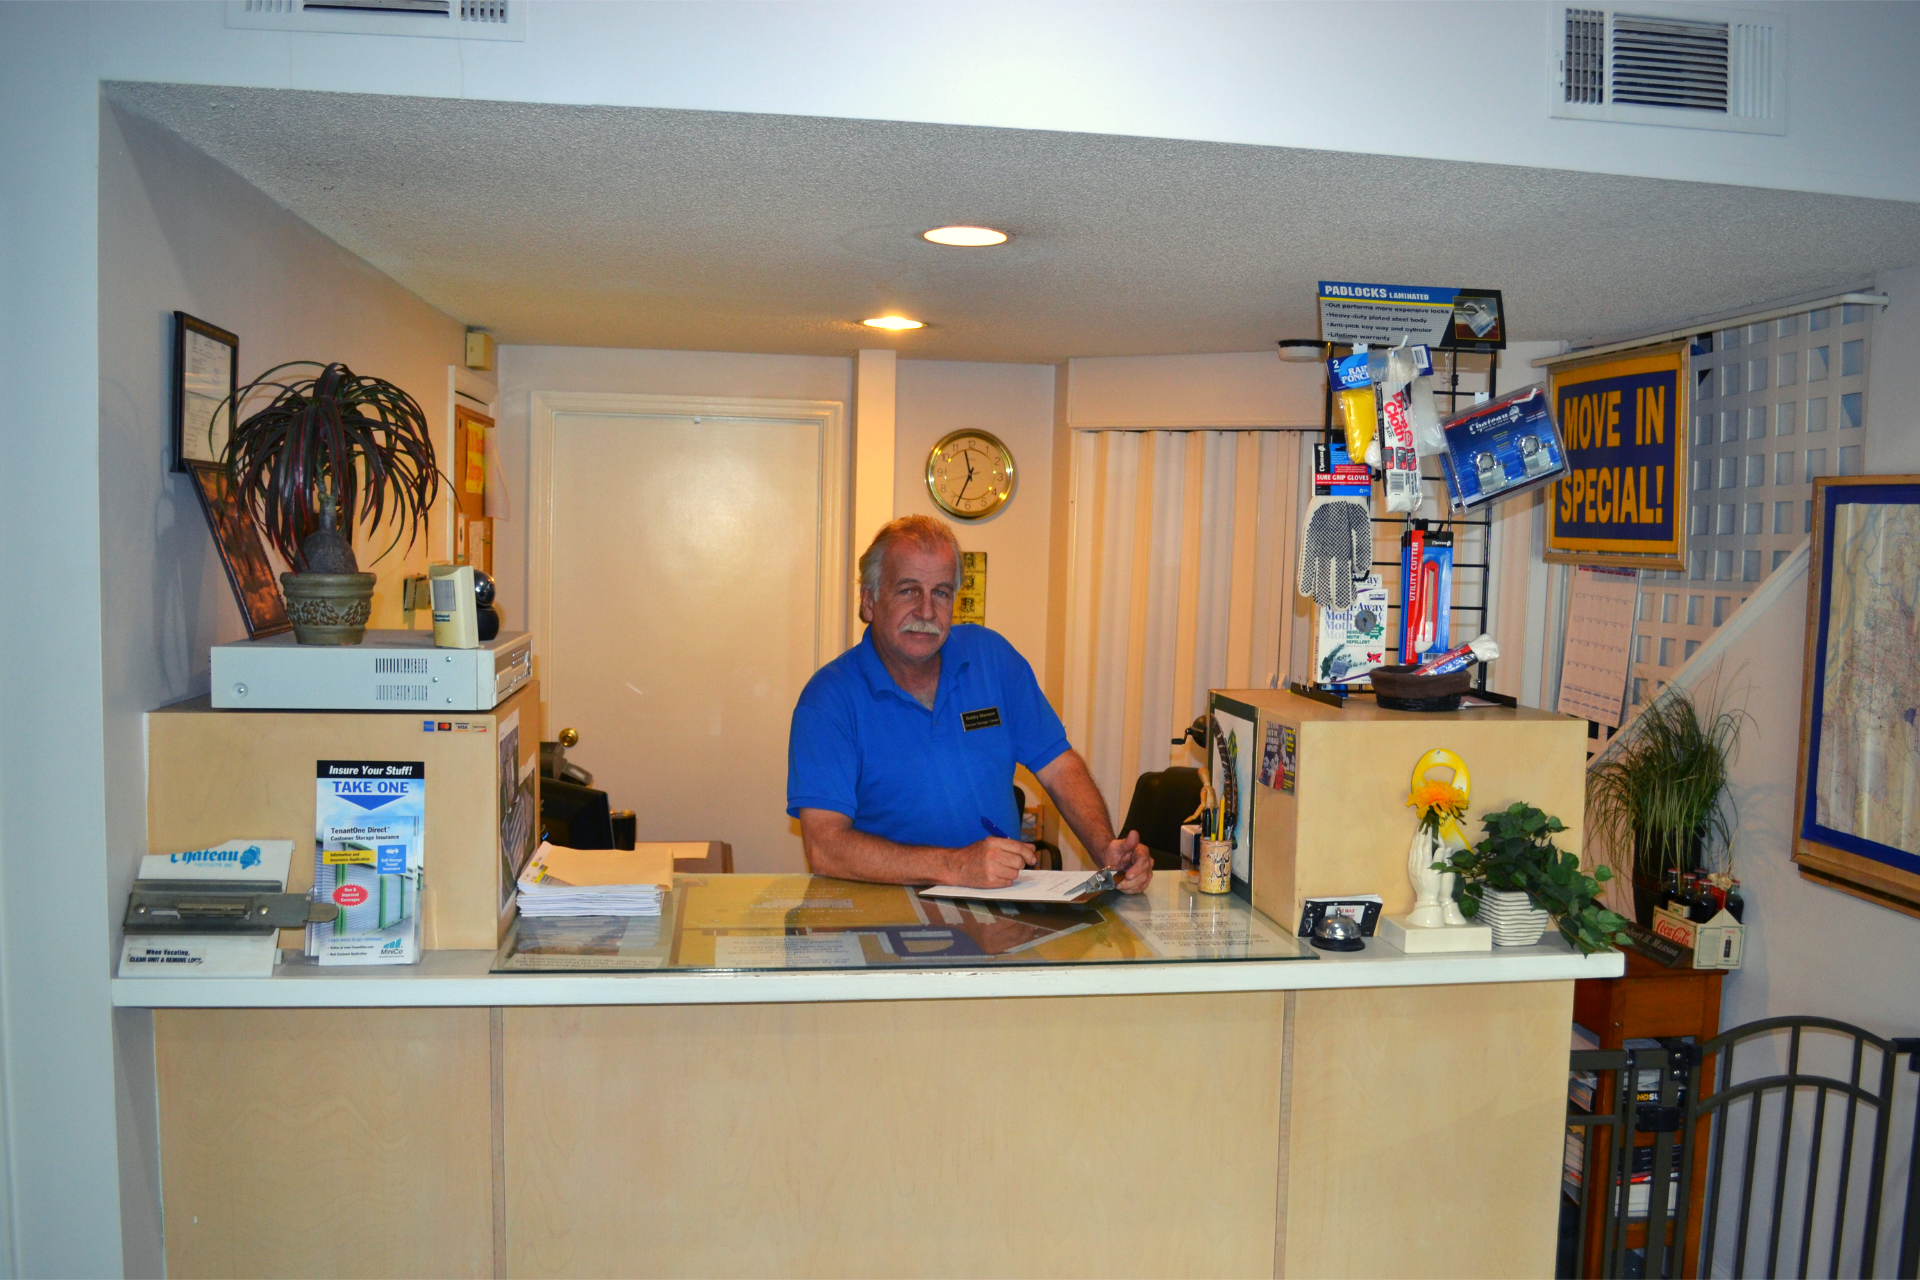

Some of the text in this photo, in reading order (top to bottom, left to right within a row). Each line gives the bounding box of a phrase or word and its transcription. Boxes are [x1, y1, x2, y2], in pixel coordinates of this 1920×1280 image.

[1325, 285, 1429, 301] PADLOCKS LAMINATED
[1330, 312, 1367, 320] Heavy-duty
[1333, 360, 1339, 369] 2
[1384, 402, 1405, 442] Cloth
[1469, 412, 1508, 435] Chateau
[1564, 385, 1665, 450] MOVE IN
[1561, 466, 1665, 524] SPECIAL!
[1411, 542, 1419, 571] CUTTER
[329, 765, 413, 776] Insure Your Stuff!
[332, 781, 409, 793] TAKE ONE
